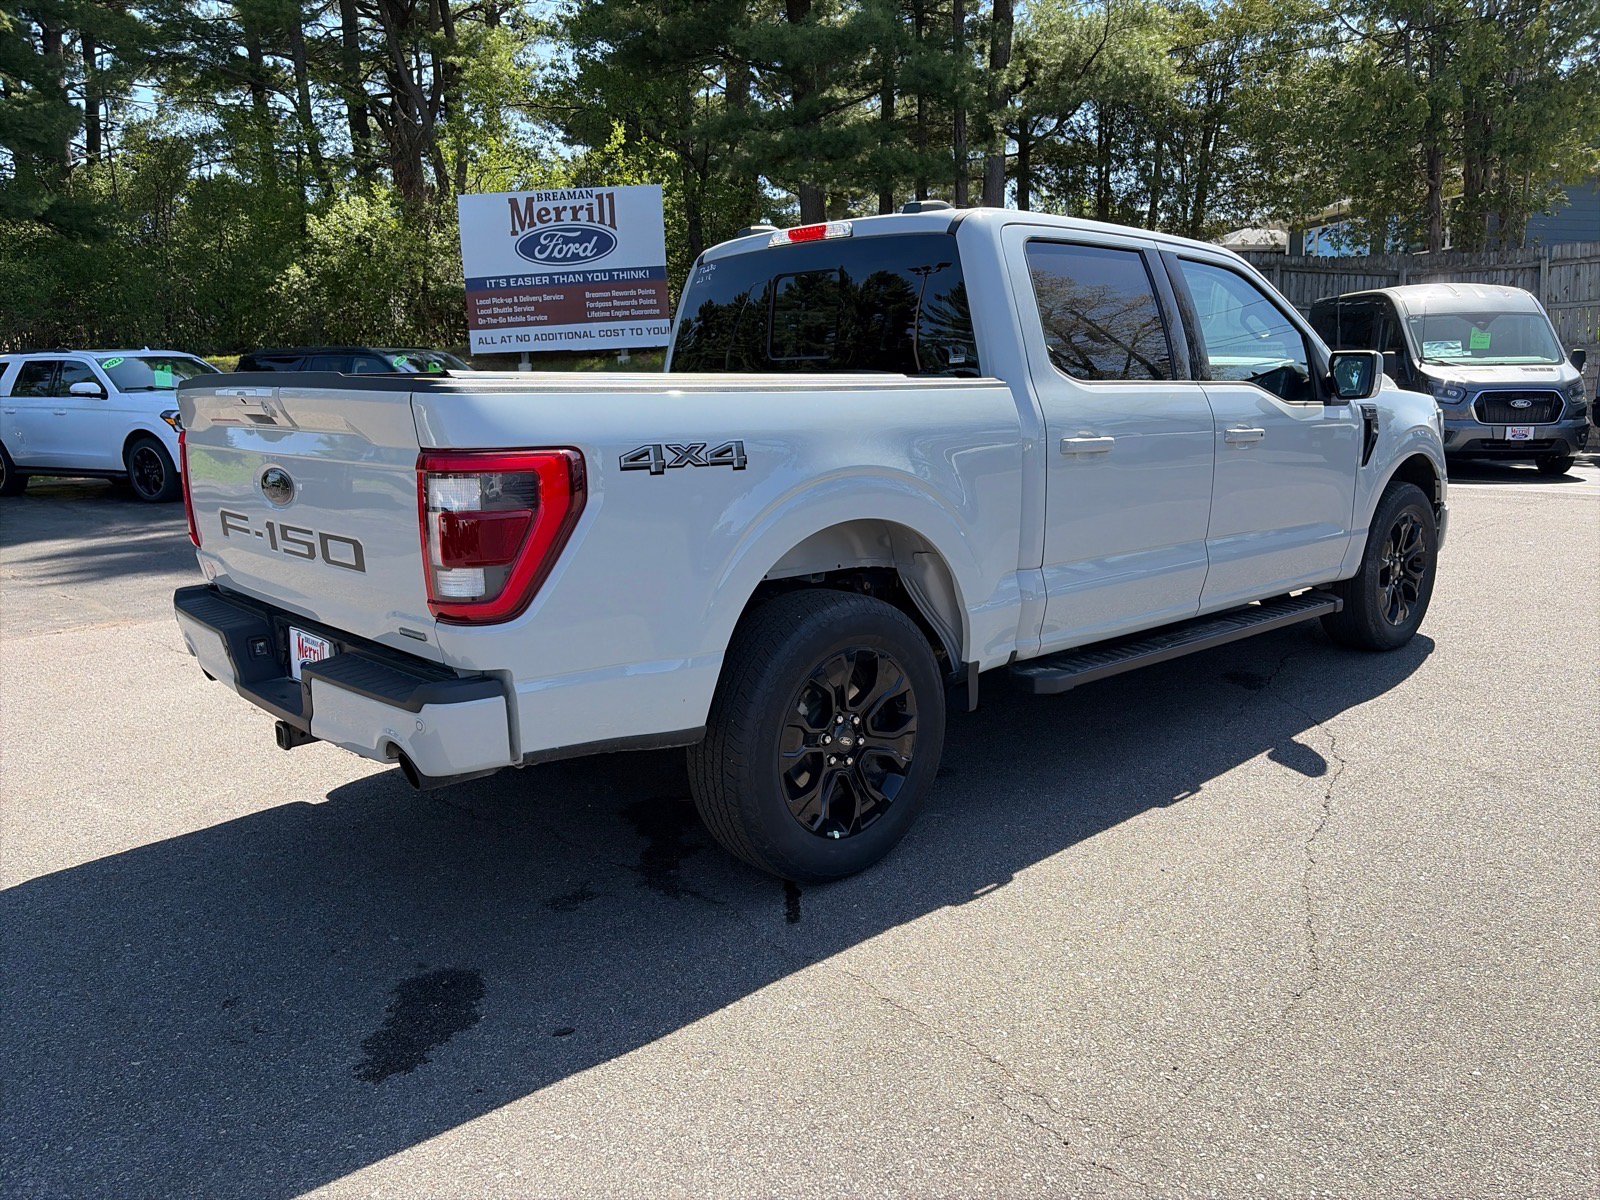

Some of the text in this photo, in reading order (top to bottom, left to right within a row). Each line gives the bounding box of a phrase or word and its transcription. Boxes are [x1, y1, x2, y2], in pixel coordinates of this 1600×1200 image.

[536, 189, 594, 203] BREAMAN
[507, 191, 618, 237] Merrill
[533, 230, 598, 260] Ford
[486, 269, 650, 288] IT'S EASIER THAN YOU THINK!
[475, 297, 491, 306] Local
[491, 297, 513, 305] Pick-up
[519, 294, 542, 303] Delivery
[542, 293, 565, 301] Service
[611, 289, 637, 297] Rewards
[477, 305, 535, 315] Local Shuttle Service
[586, 301, 612, 309] Fordpass
[612, 299, 638, 307] Rewards
[478, 314, 548, 325] On-The-Go Mobile Service
[611, 310, 630, 318] Engine
[631, 308, 660, 316] Guarantee
[478, 336, 497, 346] ALL
[500, 335, 513, 344] AT
[515, 334, 531, 343] NO
[533, 329, 596, 342] ADDITIONAL
[598, 328, 626, 338] COST
[629, 327, 643, 336] TO
[219, 508, 367, 574] F-150
[297, 635, 325, 661] Merrill
